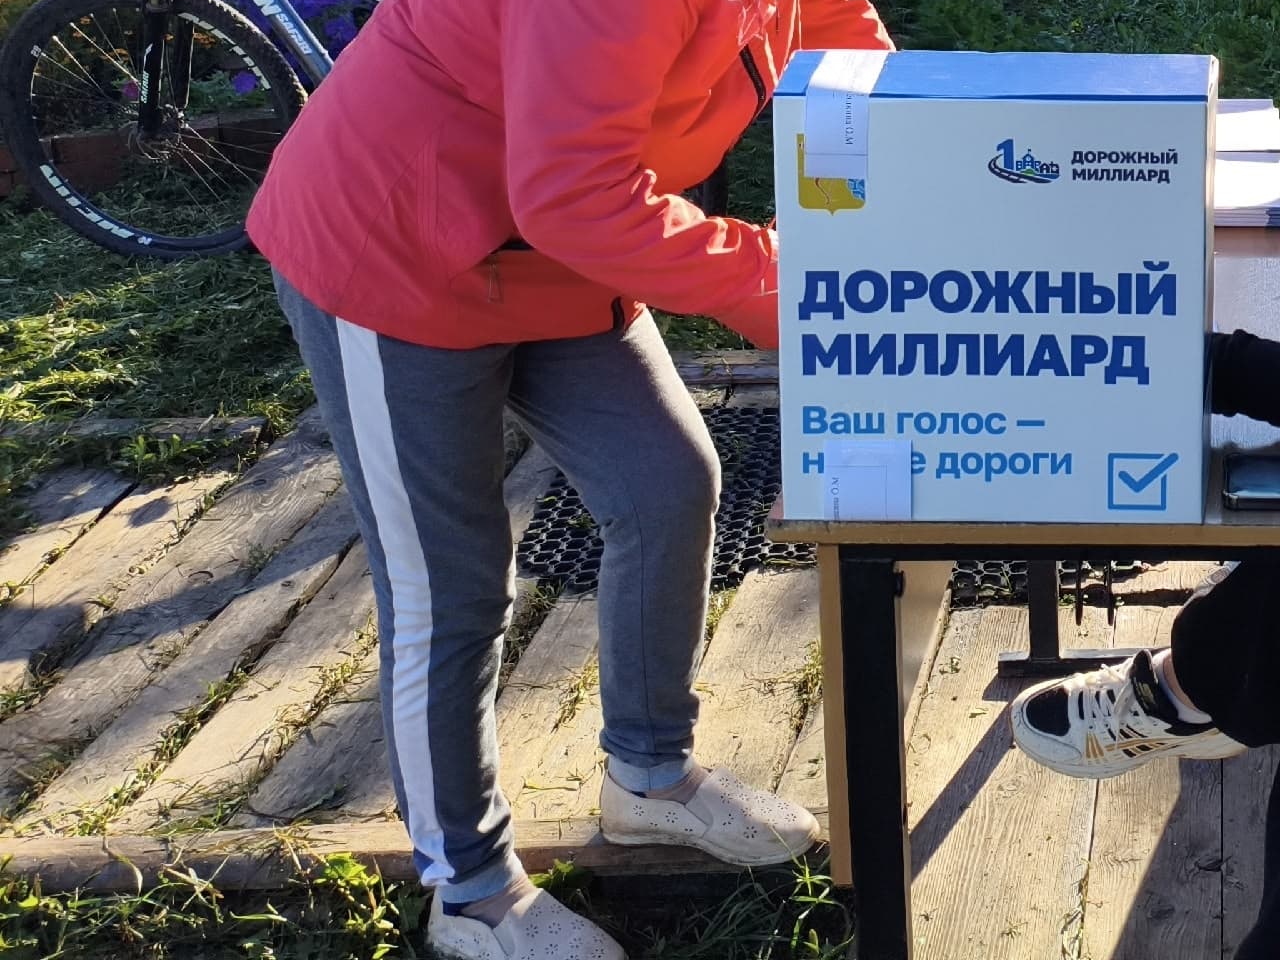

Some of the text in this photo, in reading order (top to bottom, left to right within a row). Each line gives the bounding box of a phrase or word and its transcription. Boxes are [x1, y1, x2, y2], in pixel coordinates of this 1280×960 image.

[1071, 149, 1179, 165] ДОРОЖНЫЙ
[1072, 168, 1171, 184] МИЛЛИАРД
[798, 261, 1177, 320] ДОРОЖНЫЙ
[801, 333, 1150, 385] МИЛЛИАРД
[802, 406, 885, 435] Ваш
[897, 411, 1007, 435] голос
[935, 452, 1073, 482] дороги
